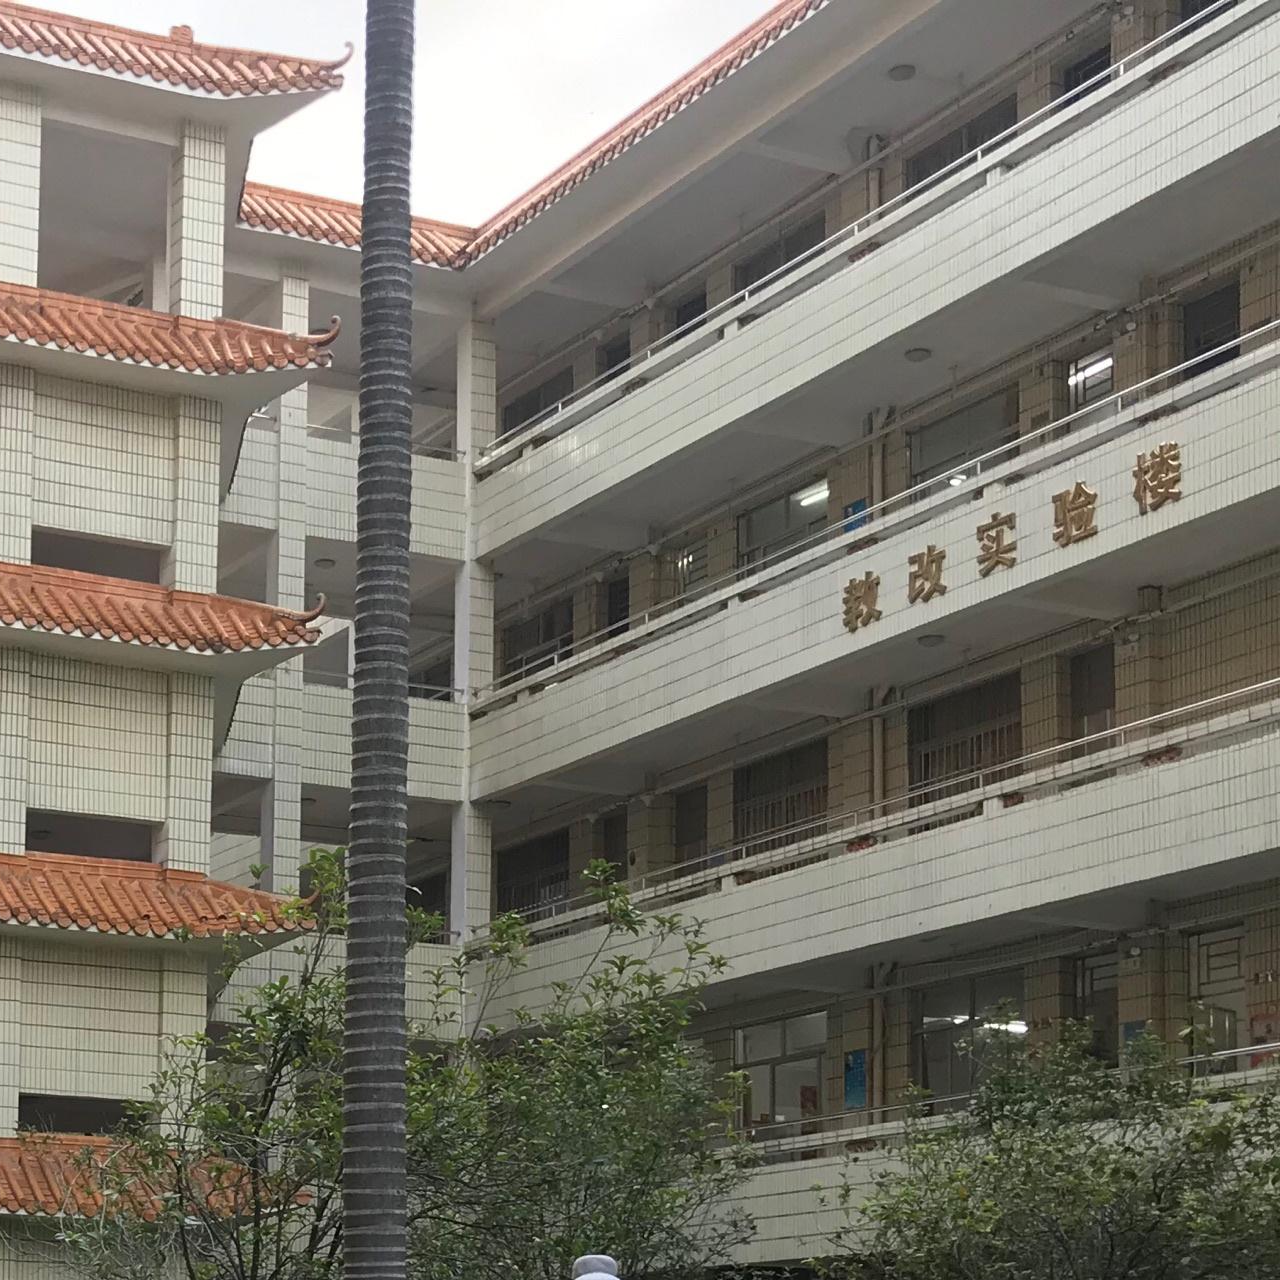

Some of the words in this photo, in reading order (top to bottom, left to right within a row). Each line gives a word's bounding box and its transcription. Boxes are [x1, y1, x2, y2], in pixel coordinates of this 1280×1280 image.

[842, 440, 1182, 633] 教改实验楼
